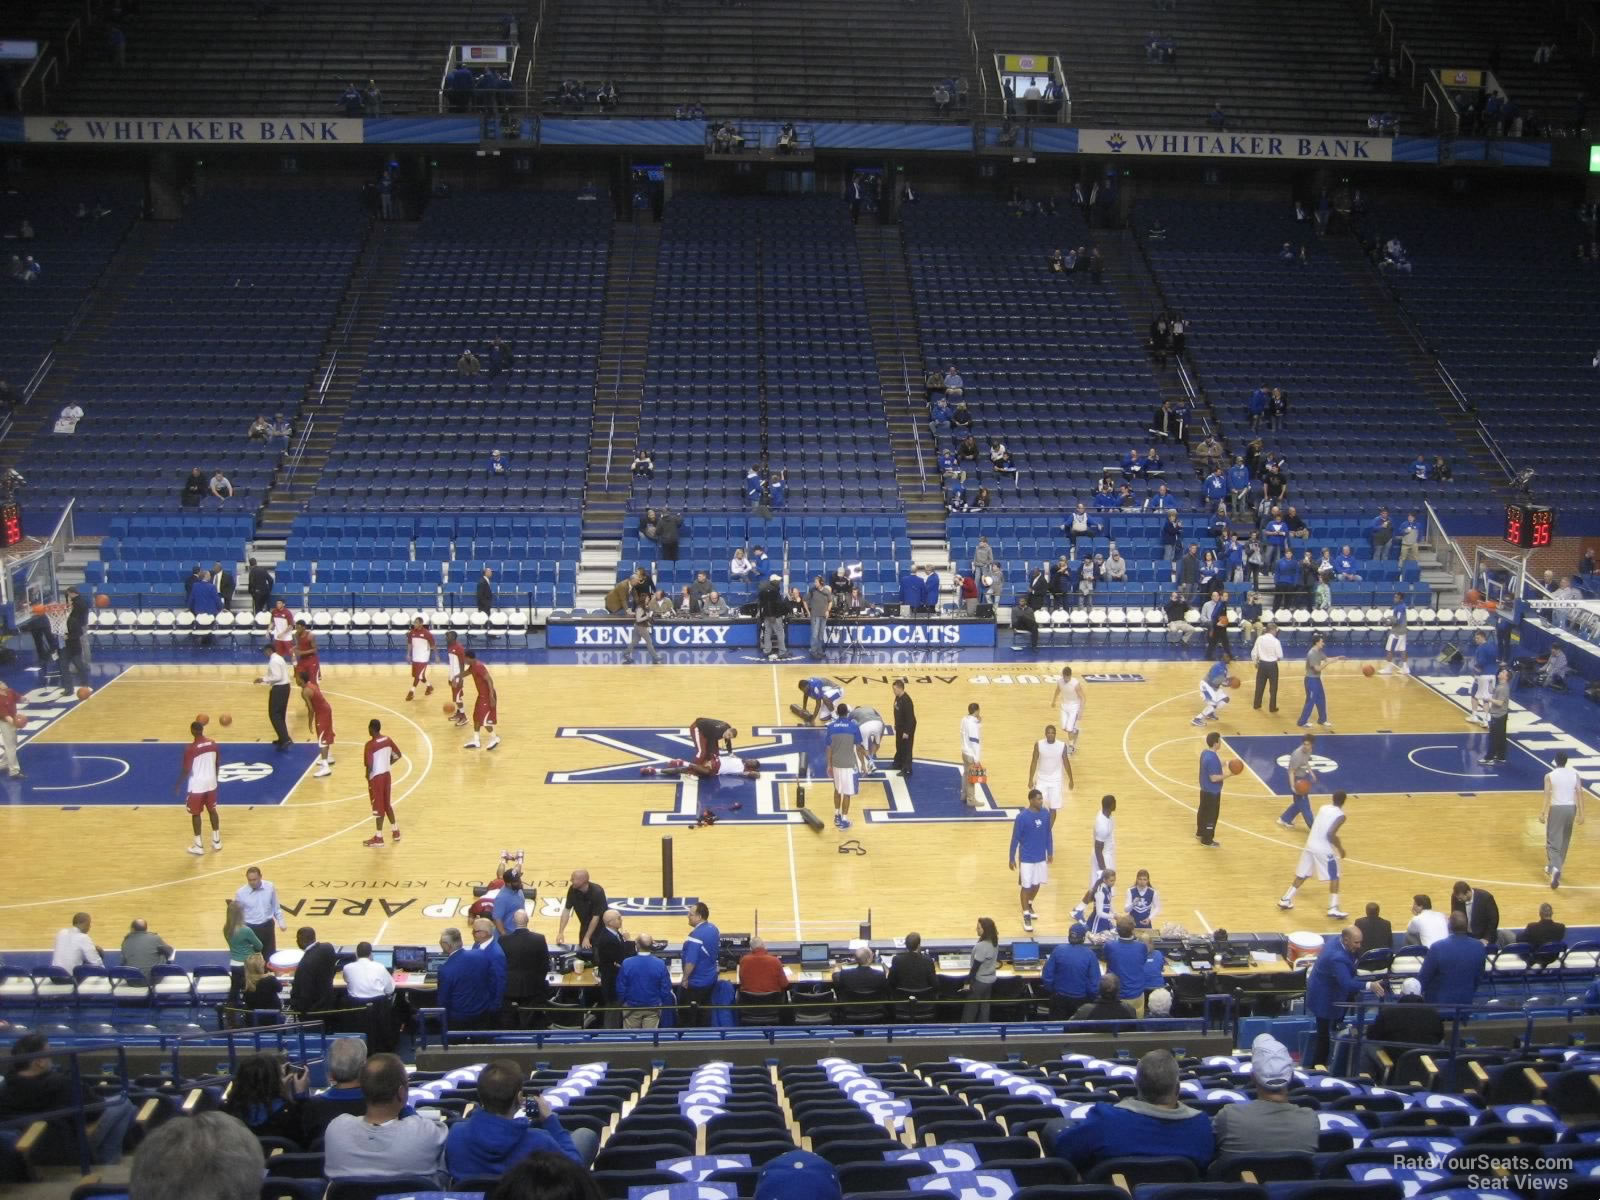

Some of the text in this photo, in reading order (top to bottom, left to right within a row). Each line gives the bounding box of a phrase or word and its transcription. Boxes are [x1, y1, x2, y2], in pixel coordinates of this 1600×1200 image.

[86, 121, 339, 140] WHITAKER BANK
[1136, 135, 1369, 158] WHITAKER BANK
[1532, 524, 1549, 545] 35
[575, 624, 960, 645] KENUCKY WILDCATS
[303, 880, 428, 888] KENTUCKY
